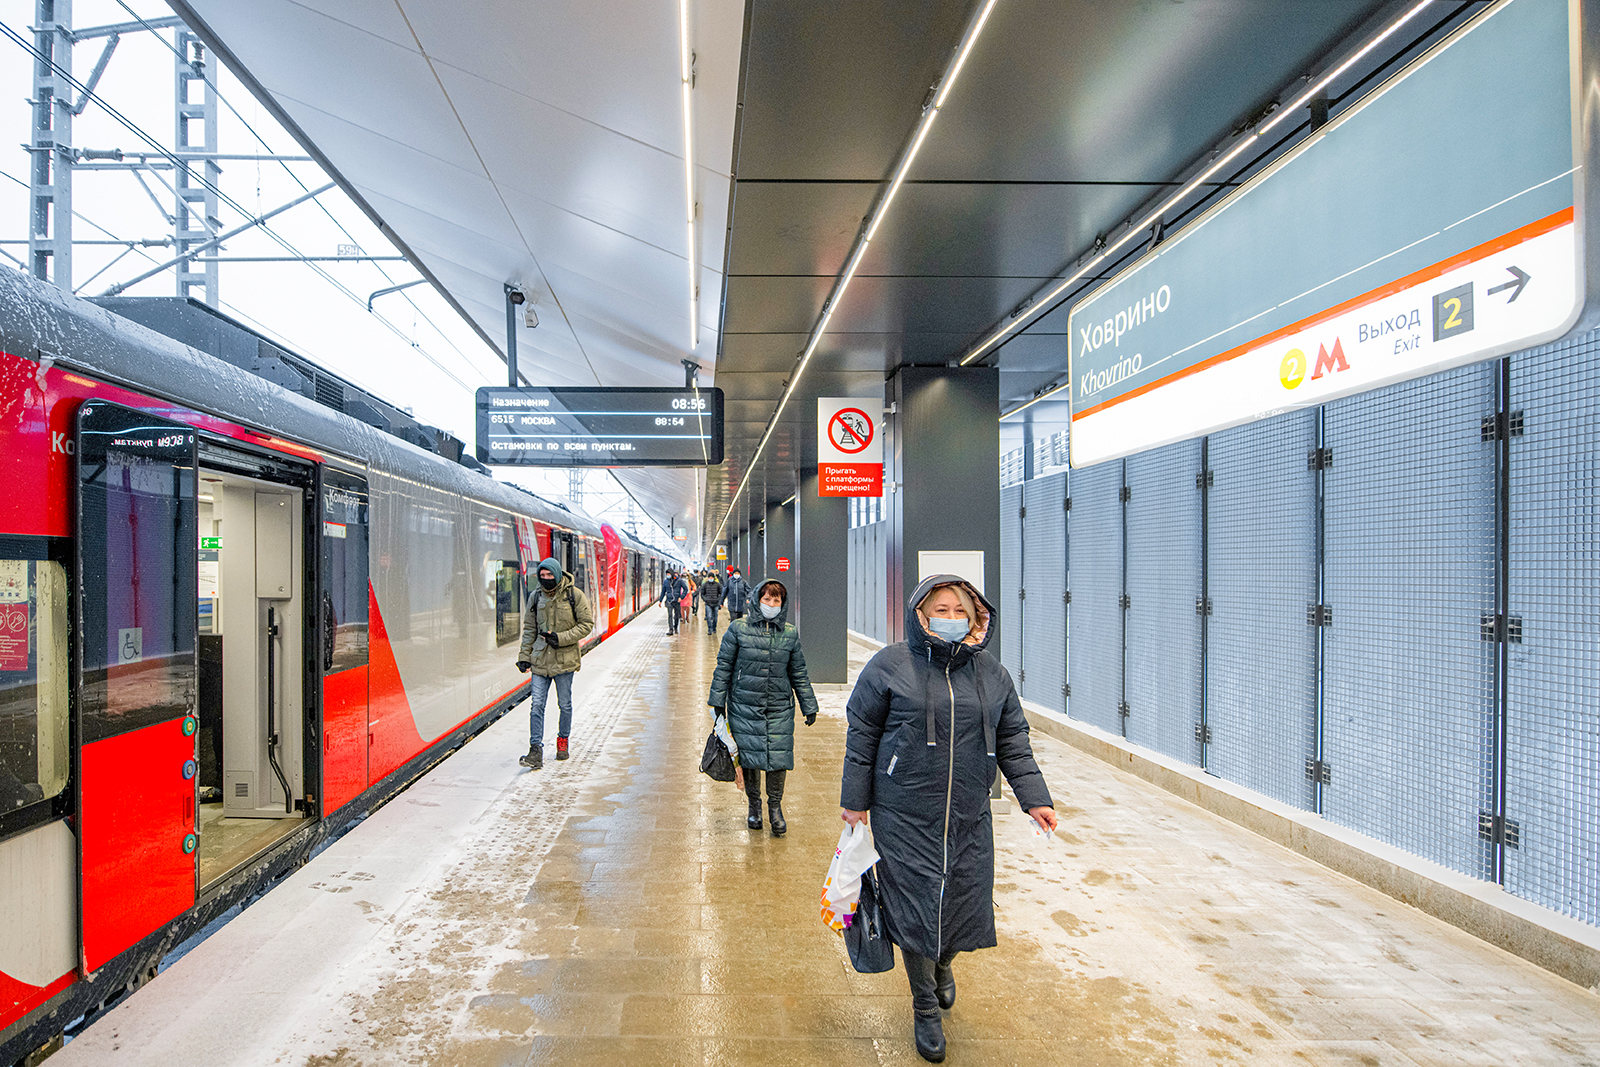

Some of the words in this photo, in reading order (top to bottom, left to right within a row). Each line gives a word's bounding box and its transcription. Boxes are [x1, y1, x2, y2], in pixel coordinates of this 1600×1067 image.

[1080, 284, 1171, 358] Ховрино
[1358, 308, 1421, 343] Выход
[1443, 297, 1463, 330] 2
[1393, 334, 1421, 355] Exit
[1080, 353, 1142, 397] Khovrino
[1286, 357, 1299, 382] 2
[493, 397, 550, 407] Назначение
[671, 398, 706, 410] 08:56
[491, 414, 515, 424] 6515
[521, 416, 556, 426] МОСКВА
[491, 441, 543, 451] Остановки
[546, 442, 559, 451] по
[563, 442, 587, 451] всем
[591, 442, 636, 452] пунктам.
[825, 467, 856, 475] Прыгать
[831, 476, 874, 484] платформы
